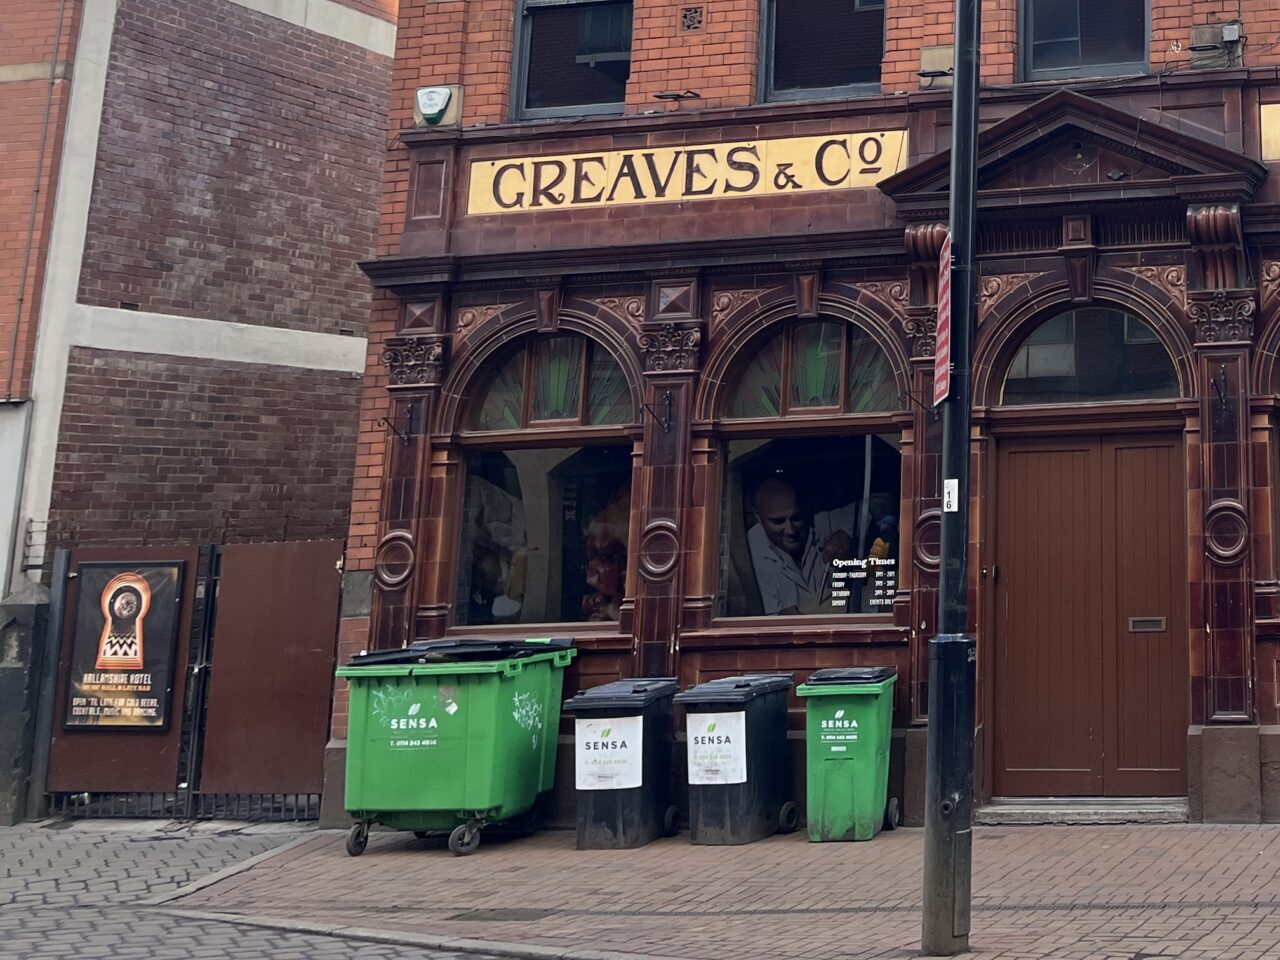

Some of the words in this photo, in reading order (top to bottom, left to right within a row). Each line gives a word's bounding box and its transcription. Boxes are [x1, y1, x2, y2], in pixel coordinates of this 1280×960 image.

[493, 145, 762, 209] GREAVES
[773, 162, 802, 191] &
[832, 557, 868, 569] Opening
[868, 557, 896, 566] Times
[82, 673, 129, 684] HALLAMSHIRE
[129, 673, 152, 684] HOTEL
[390, 717, 438, 730] SENSA
[821, 719, 858, 728] SENSA
[585, 740, 628, 750] SENSA
[694, 735, 732, 745] SENSA
